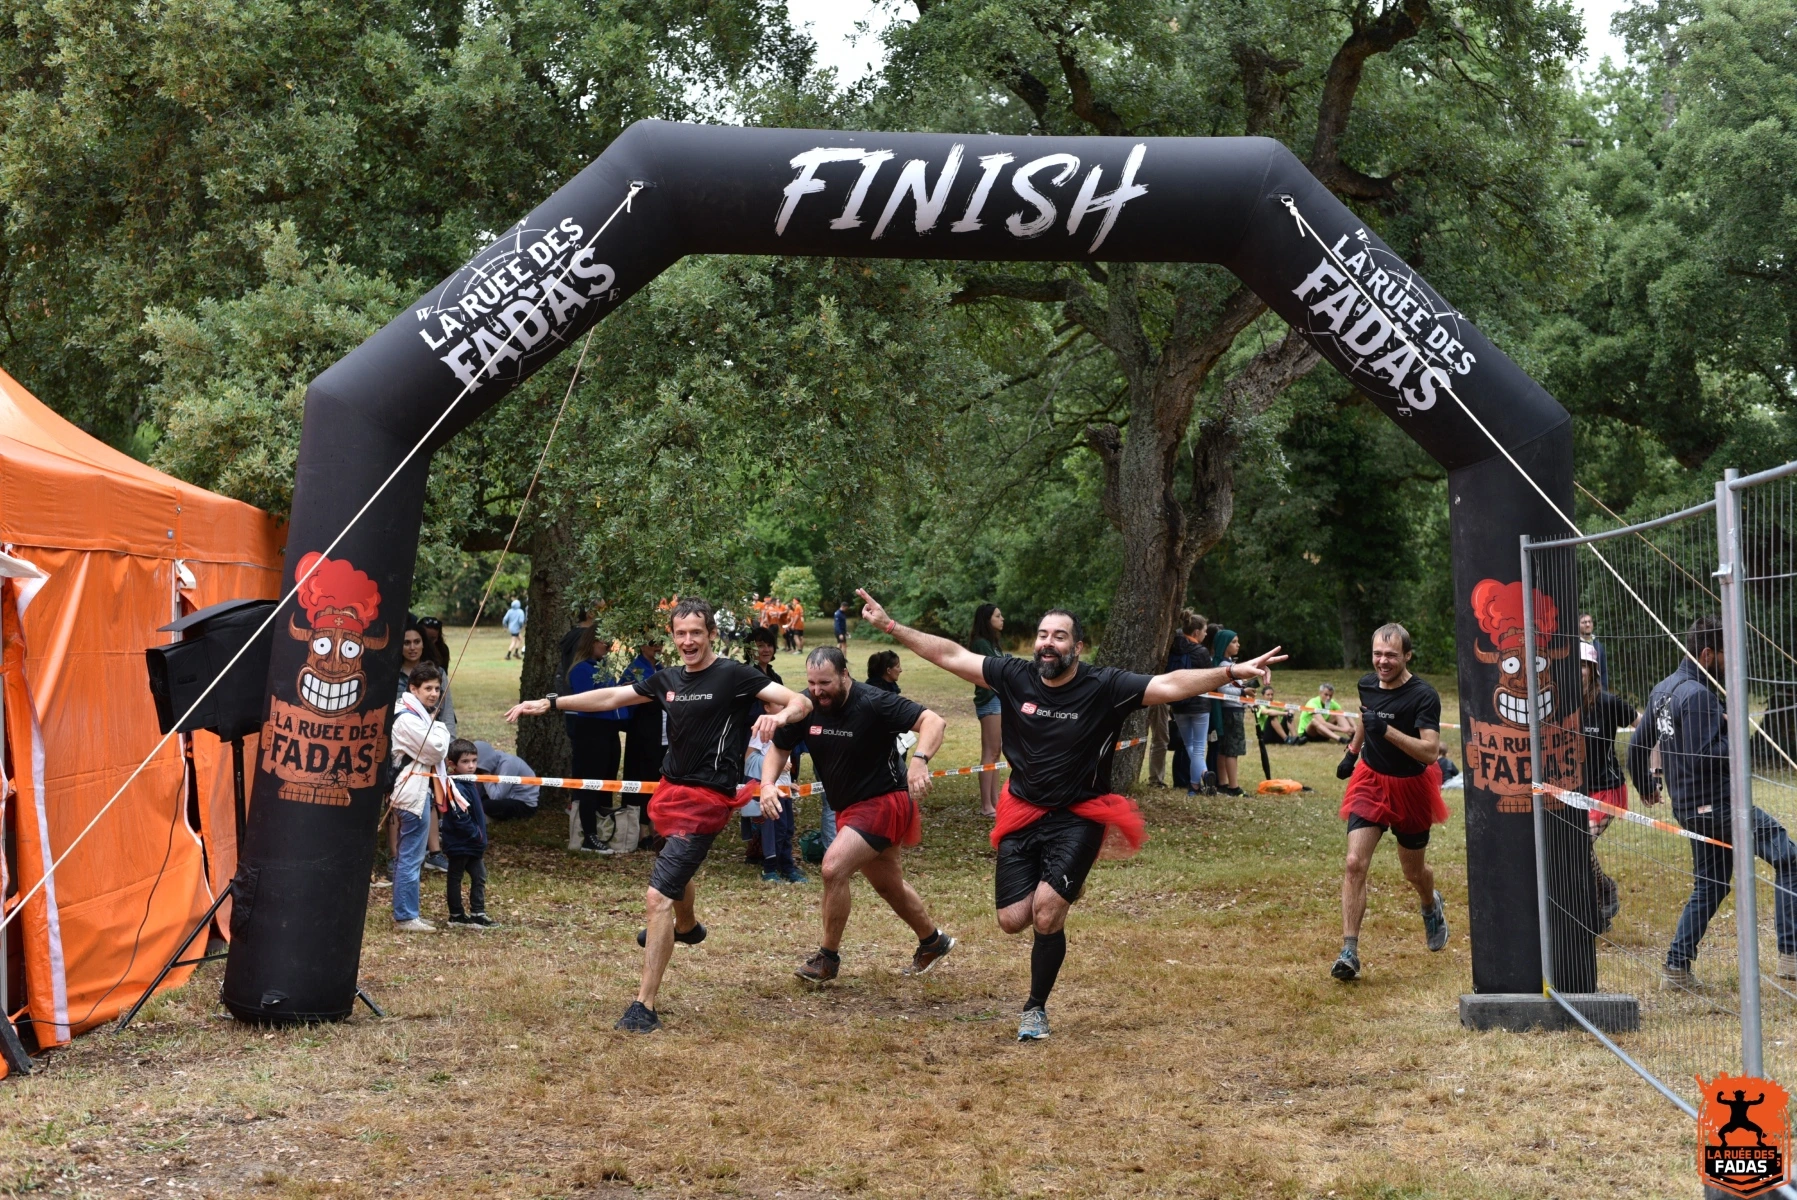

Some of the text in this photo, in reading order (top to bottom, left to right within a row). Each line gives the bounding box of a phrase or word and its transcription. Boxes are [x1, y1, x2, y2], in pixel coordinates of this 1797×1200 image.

[774, 142, 1149, 254] FINISH
[419, 217, 584, 351] LA RUEE DES
[1331, 234, 1477, 375] LA RUEE DES
[440, 247, 616, 394] FADAS
[1291, 257, 1453, 411] FADAS
[675, 693, 713, 702] solutions
[1036, 708, 1079, 720] solutions
[275, 711, 378, 741] LA RUEE DES
[822, 728, 854, 738] solutions
[1478, 732, 1499, 750] LA
[271, 731, 375, 775] FADAS
